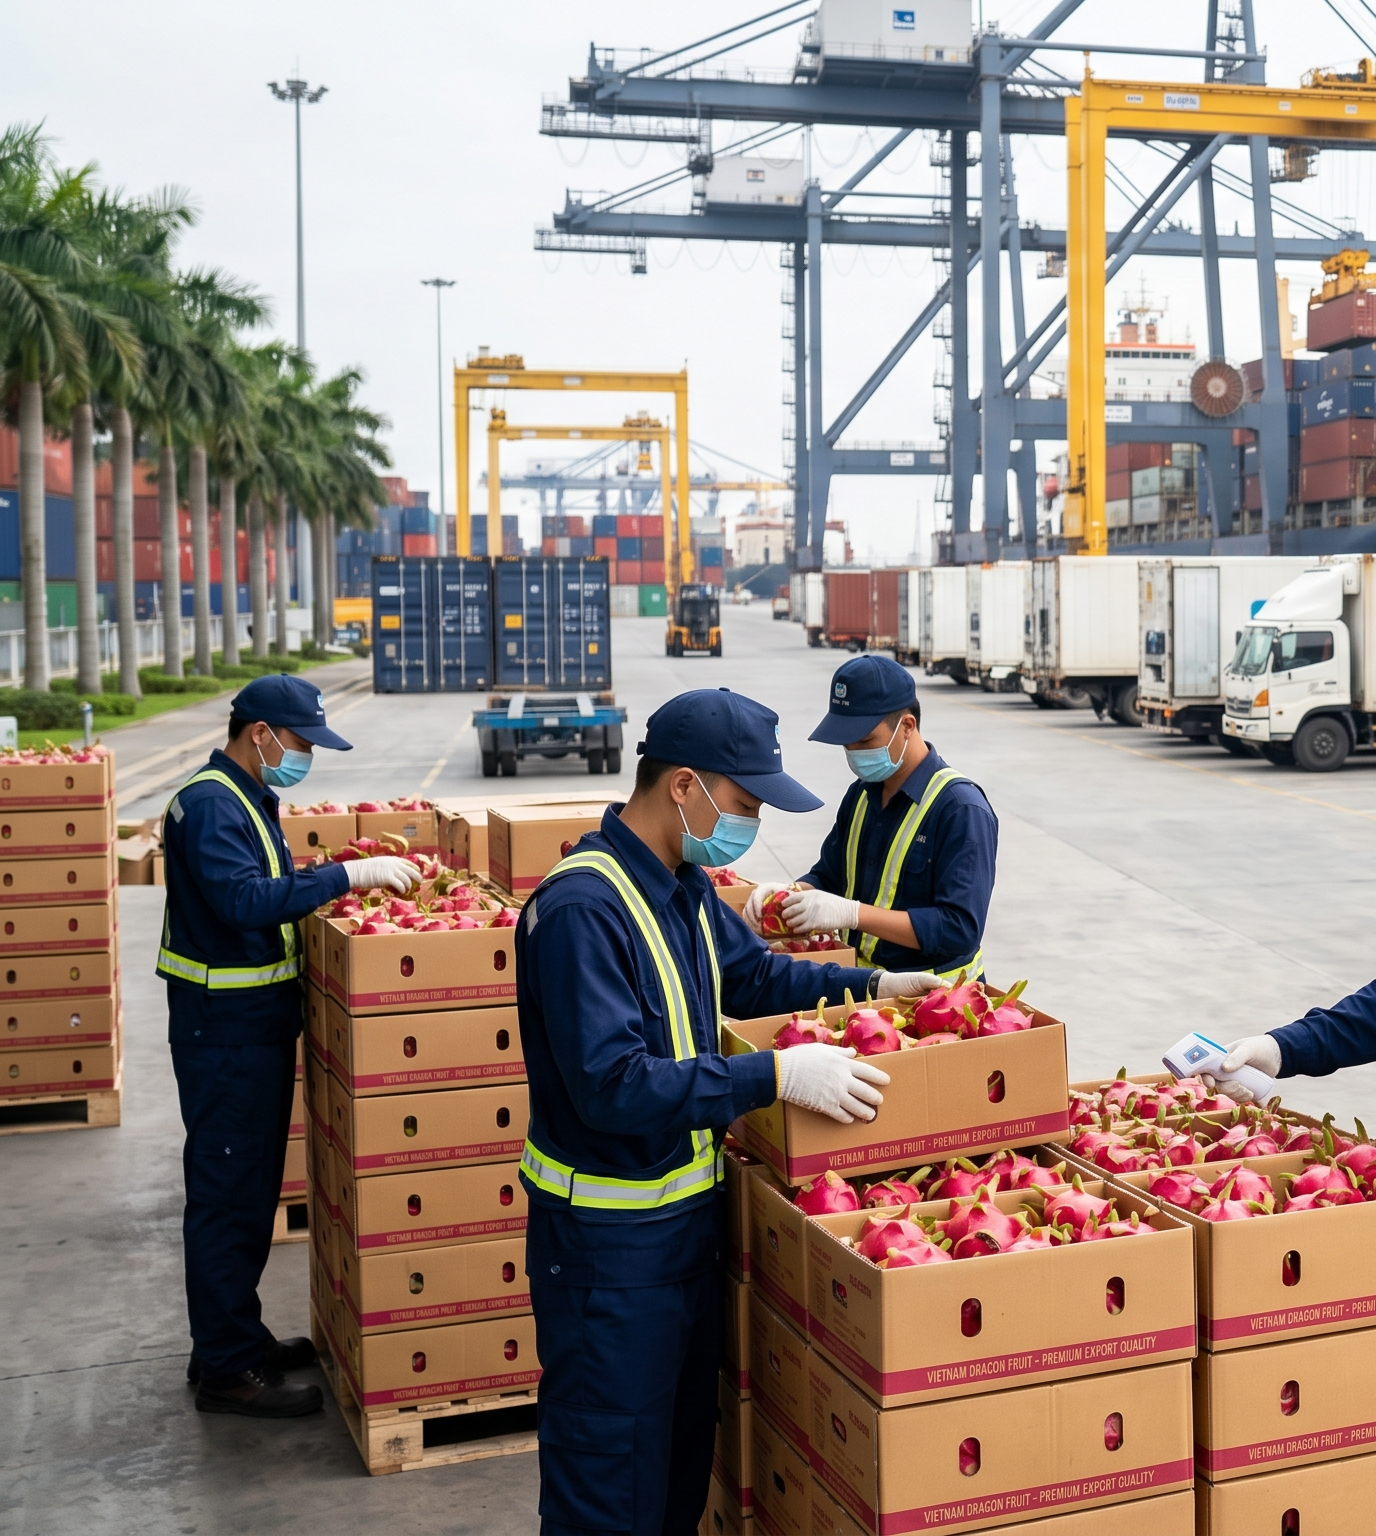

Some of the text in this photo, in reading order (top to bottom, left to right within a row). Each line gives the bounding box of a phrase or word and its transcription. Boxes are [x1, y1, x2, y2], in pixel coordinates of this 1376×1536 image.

[903, 1139, 926, 1154] FRUIT
[933, 1132, 970, 1149] PREMIUM
[1322, 1304, 1345, 1319] FRUIT
[926, 1365, 967, 1384] VIETNAM
[1008, 1355, 1033, 1371] FRUIT
[1042, 1347, 1082, 1366] PREMIUM
[1085, 1341, 1119, 1359] EXPORT
[1248, 1443, 1285, 1461] VIETNAM
[1286, 1436, 1319, 1454] DRAGON
[1321, 1432, 1344, 1447] FRUIT
[924, 1504, 965, 1524] VIETNAM
[966, 1498, 1004, 1517] DRAGON
[1005, 1493, 1031, 1510] FRUIT
[1039, 1484, 1080, 1503] PREMIUM
